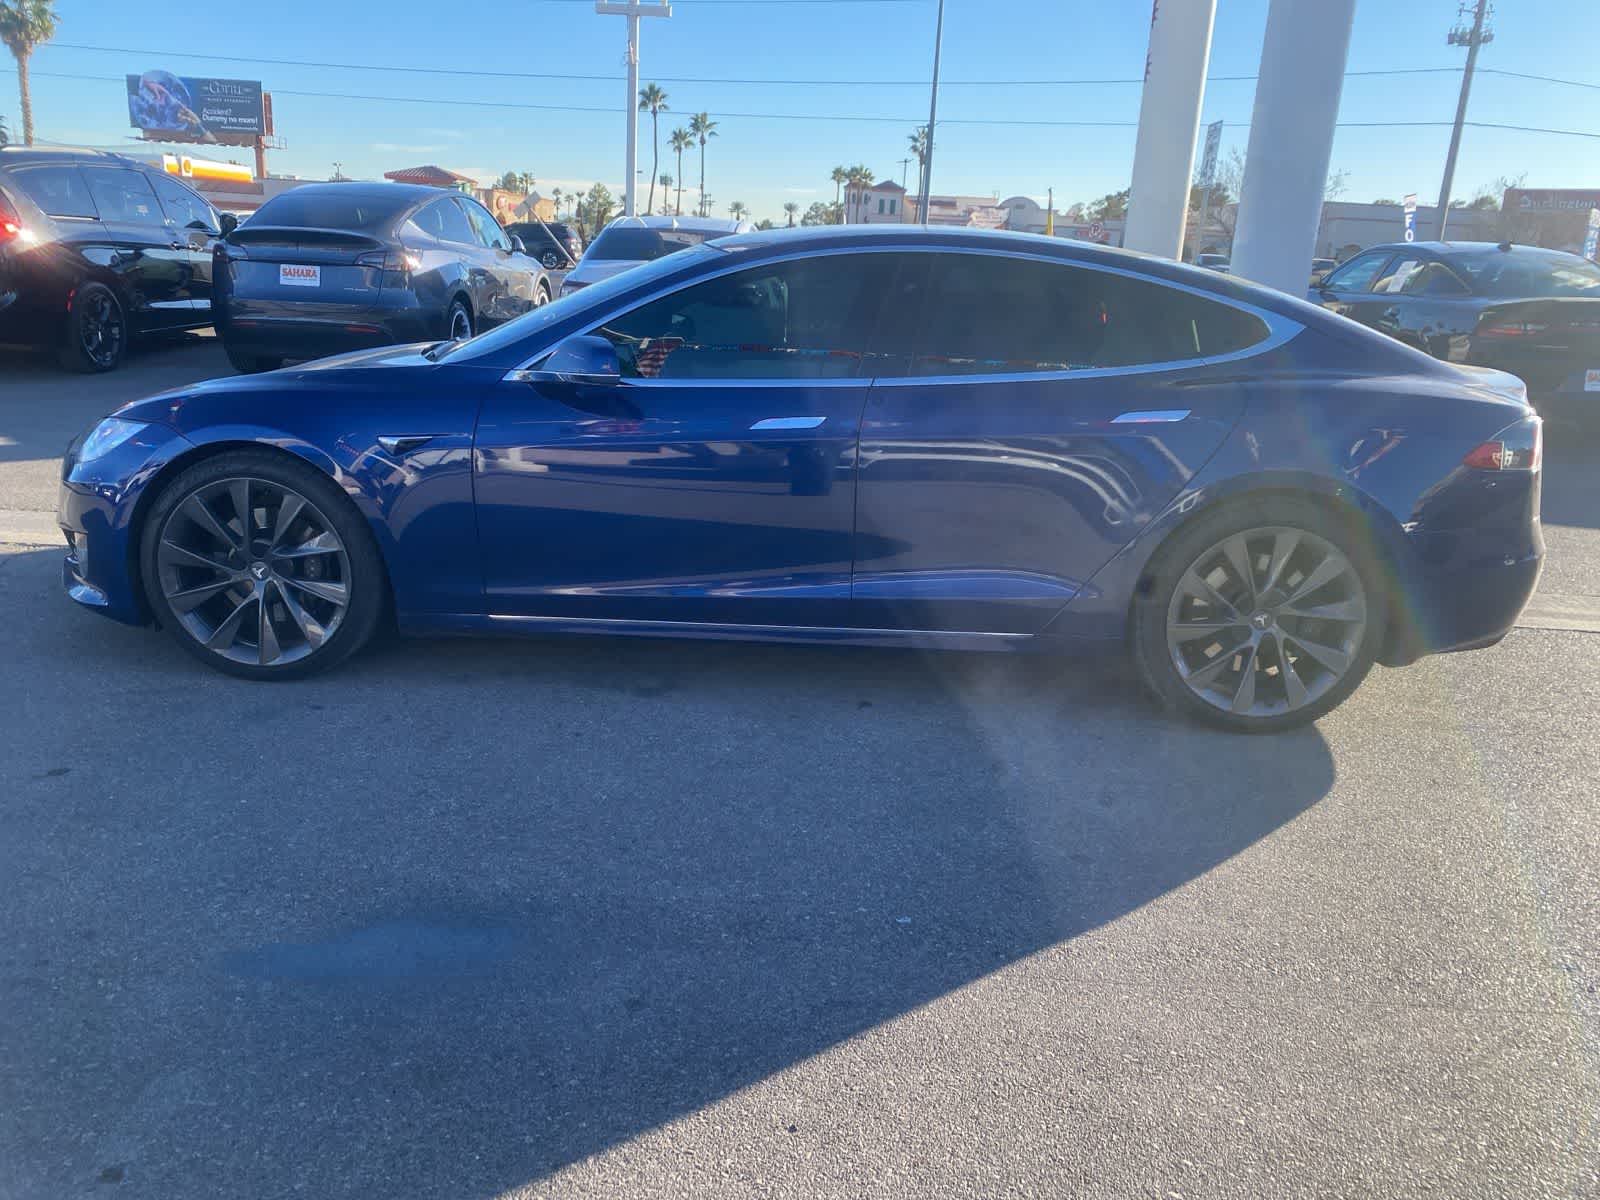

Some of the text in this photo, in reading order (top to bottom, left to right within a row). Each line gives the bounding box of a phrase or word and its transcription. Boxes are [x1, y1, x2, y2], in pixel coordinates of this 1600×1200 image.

[202, 115, 227, 124] Dummy
[238, 116, 258, 124] more!
[282, 268, 317, 277] SAHARA
